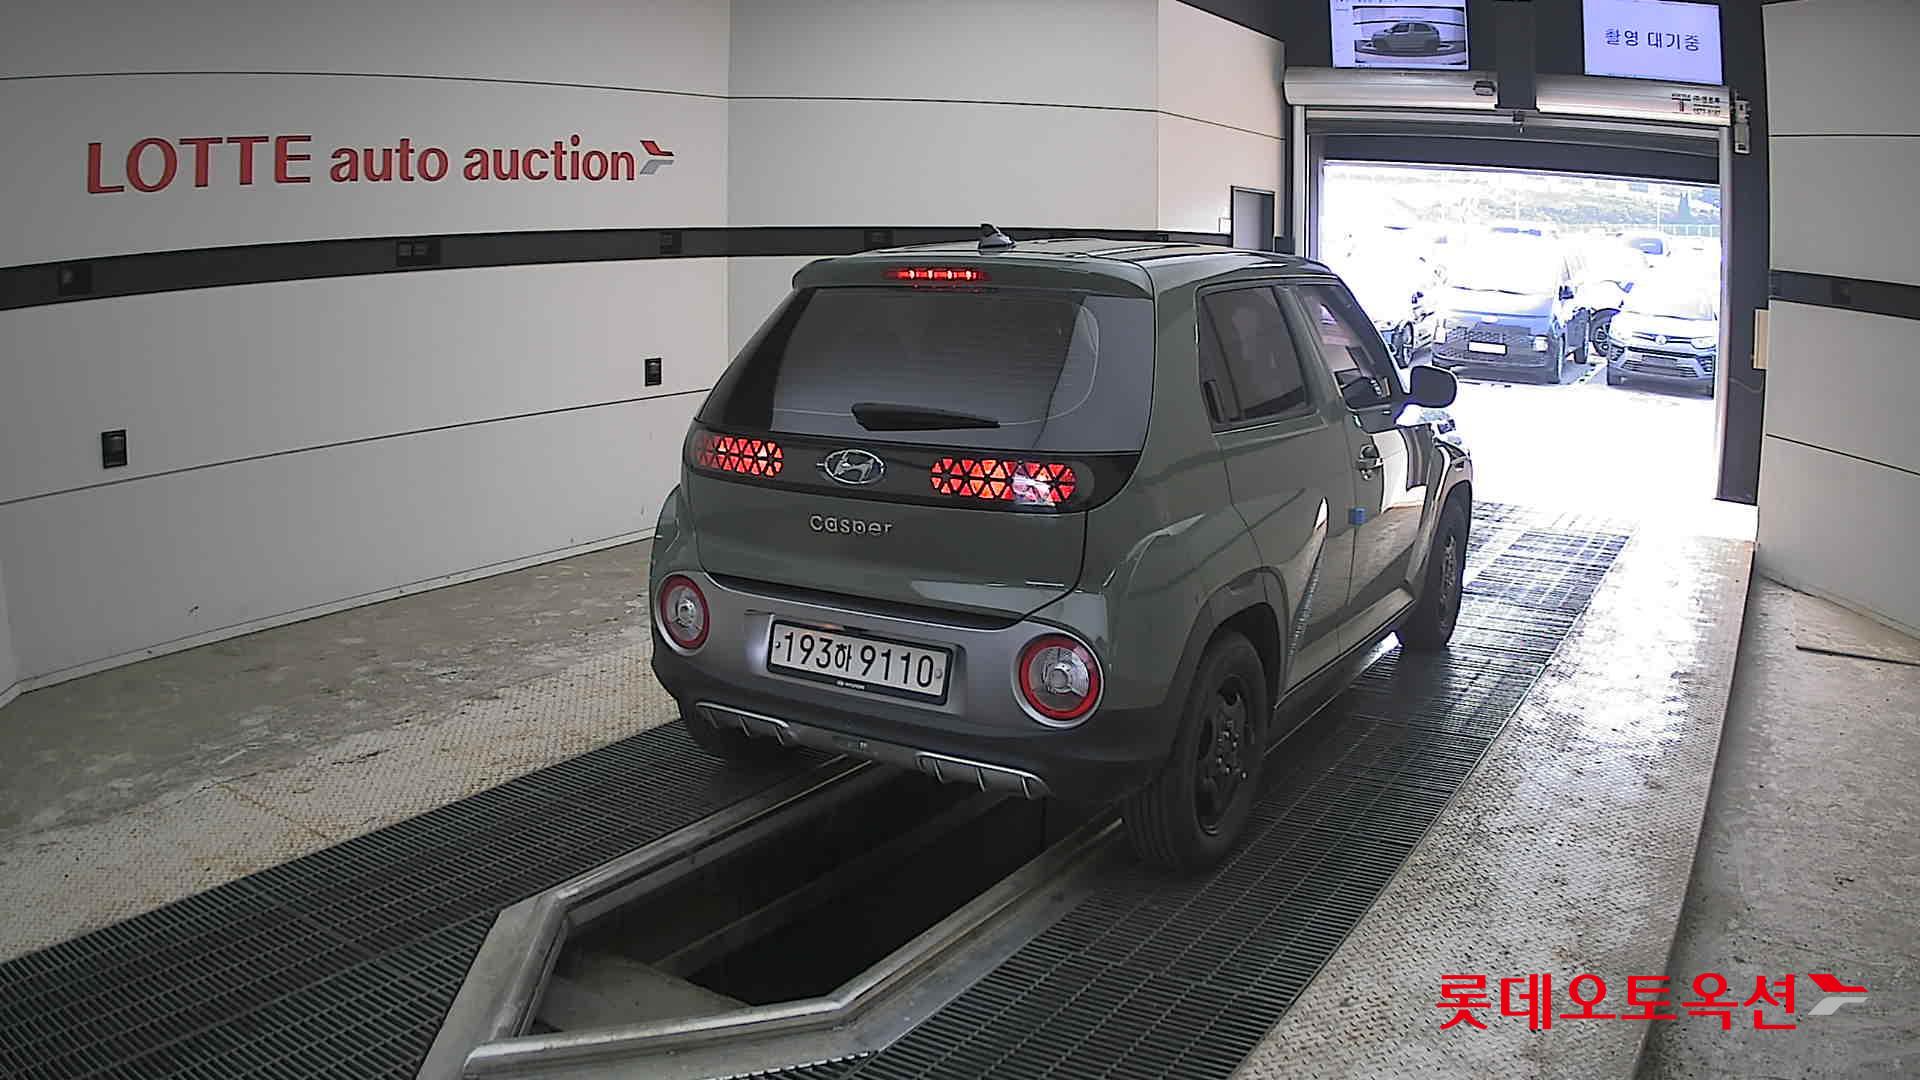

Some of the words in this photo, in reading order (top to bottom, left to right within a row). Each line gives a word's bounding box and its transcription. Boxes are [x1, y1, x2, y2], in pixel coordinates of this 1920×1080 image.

[1647, 31, 1700, 52] 대기중
[86, 134, 312, 194] LOTTE
[329, 138, 448, 182] auto
[462, 134, 635, 182] auction
[784, 631, 852, 673] 193하
[860, 645, 934, 688] 9110
